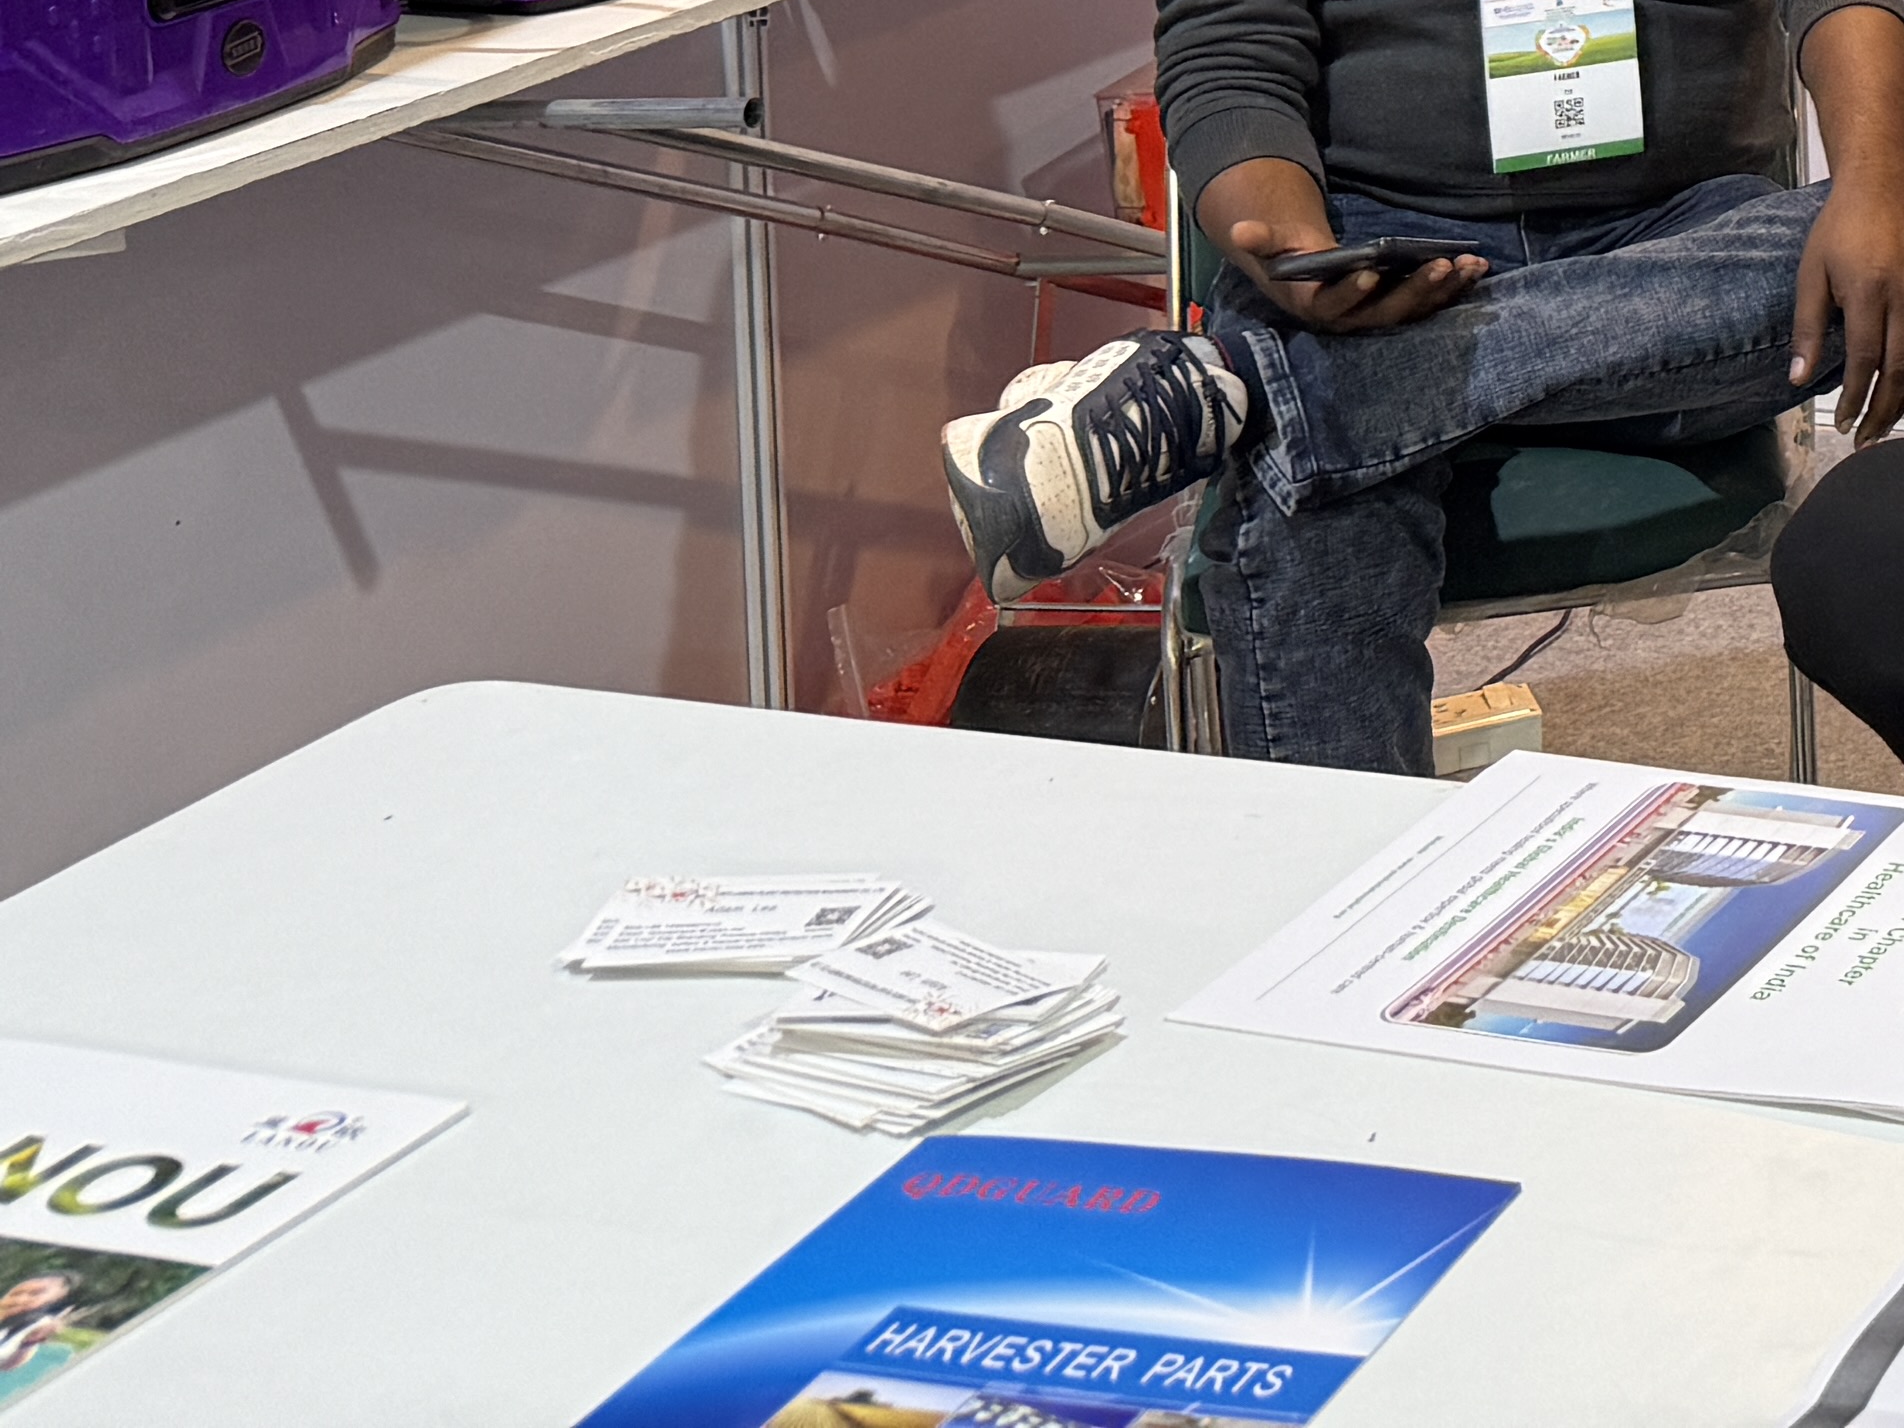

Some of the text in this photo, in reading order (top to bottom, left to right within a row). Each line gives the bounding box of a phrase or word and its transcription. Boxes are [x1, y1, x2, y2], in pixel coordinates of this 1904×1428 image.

[1546, 147, 1596, 166] FARMER
[1848, 928, 1878, 940] in
[1795, 945, 1819, 961] of
[1750, 964, 1806, 1000] India
[902, 1171, 1162, 1214] QDGUARD
[869, 1321, 1293, 1398] HARVESTER PARTS
